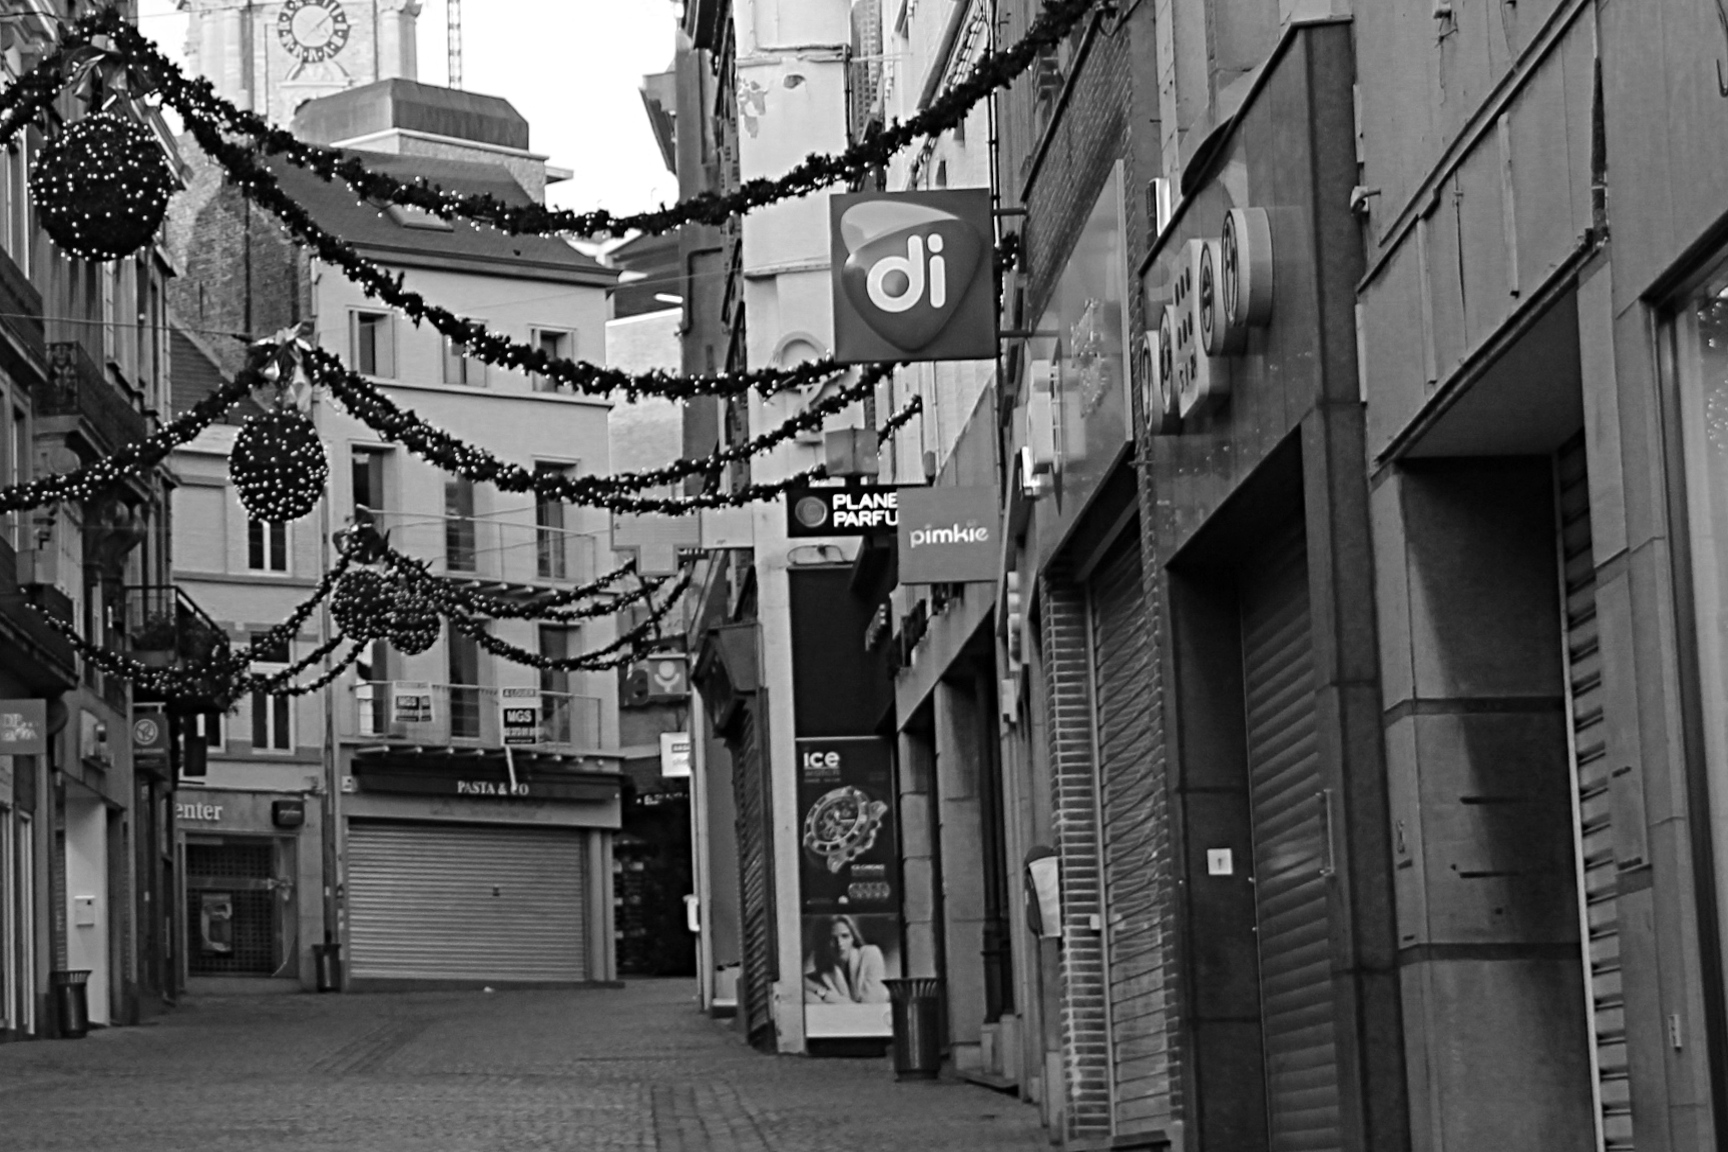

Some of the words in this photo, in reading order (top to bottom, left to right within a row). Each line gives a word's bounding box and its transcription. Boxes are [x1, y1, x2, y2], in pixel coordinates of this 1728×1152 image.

[866, 233, 946, 312] di
[909, 520, 989, 548] pimkie
[507, 710, 532, 723] MGS
[457, 779, 495, 794] PASTA
